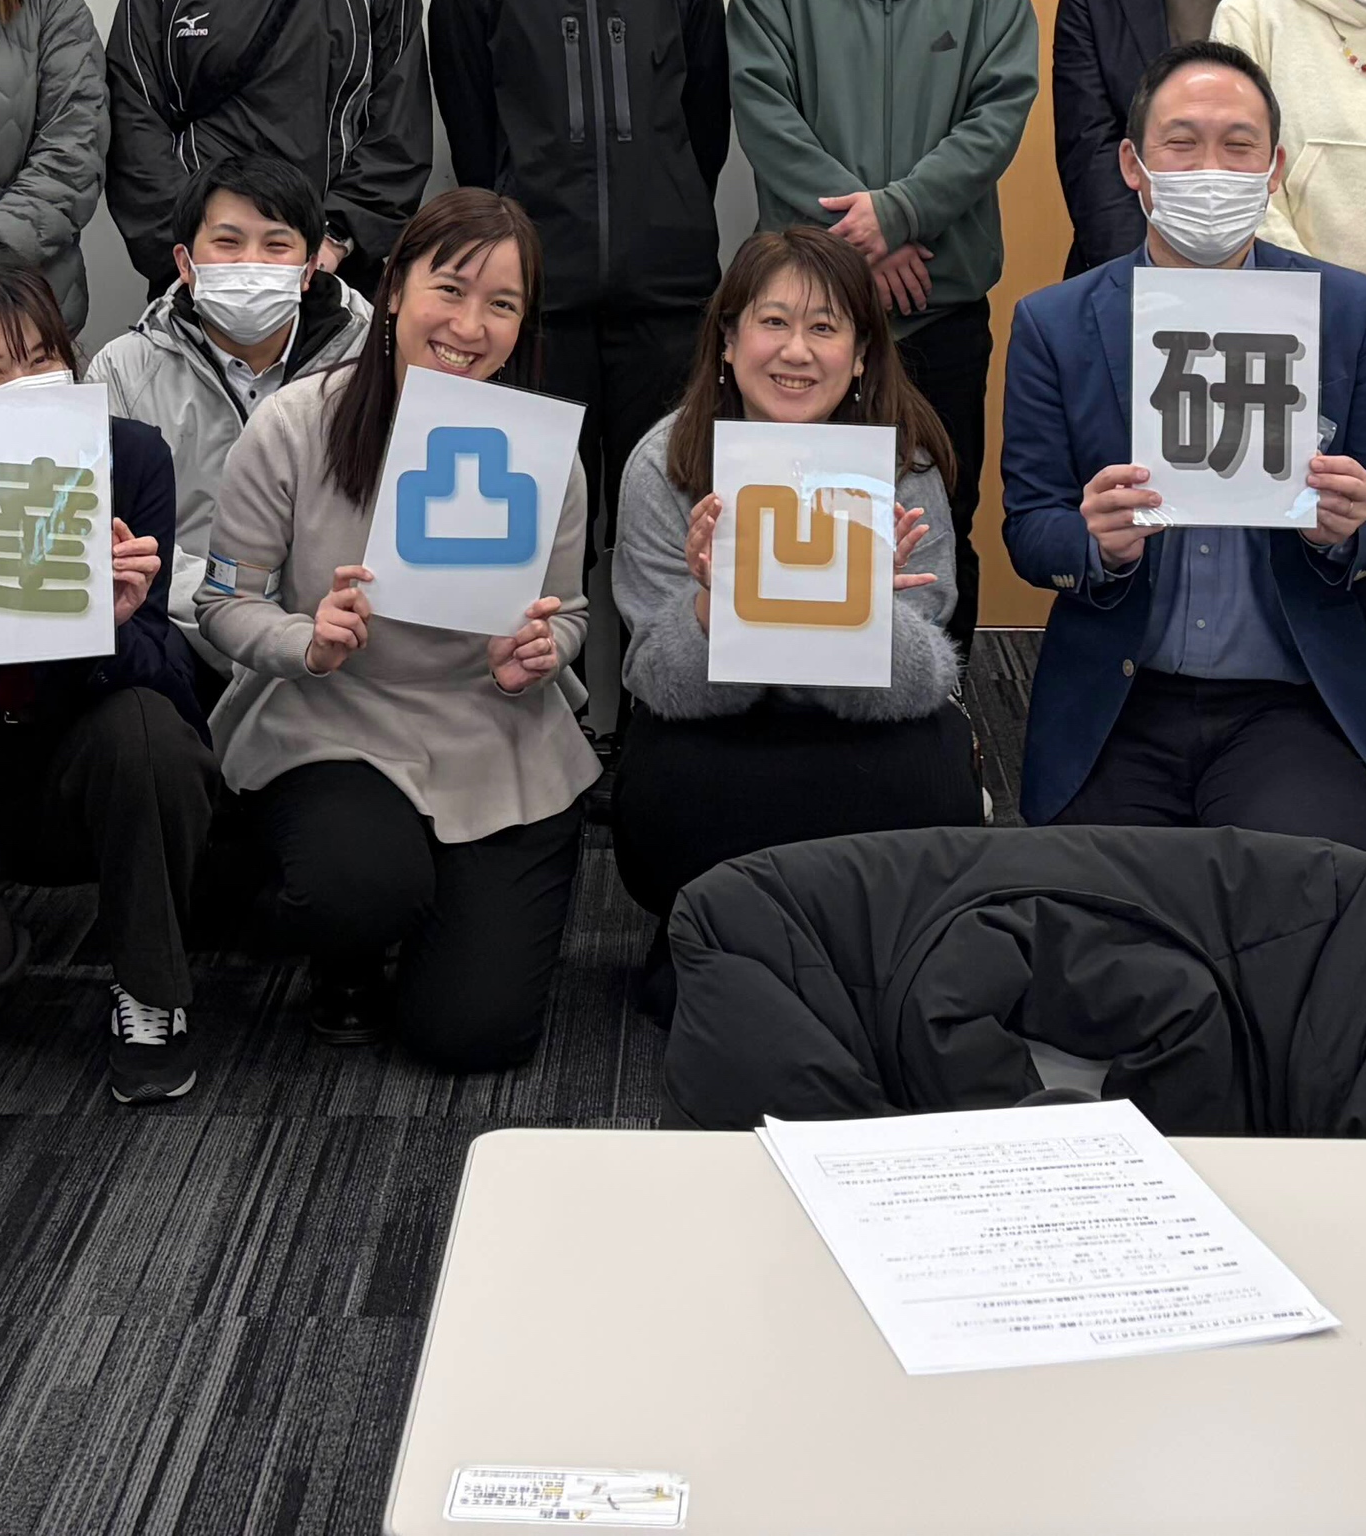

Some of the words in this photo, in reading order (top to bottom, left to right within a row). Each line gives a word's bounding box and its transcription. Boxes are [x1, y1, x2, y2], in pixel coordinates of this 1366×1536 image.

[1150, 330, 1305, 478] 研
[395, 425, 538, 567] 凸
[733, 483, 874, 627] 凹
